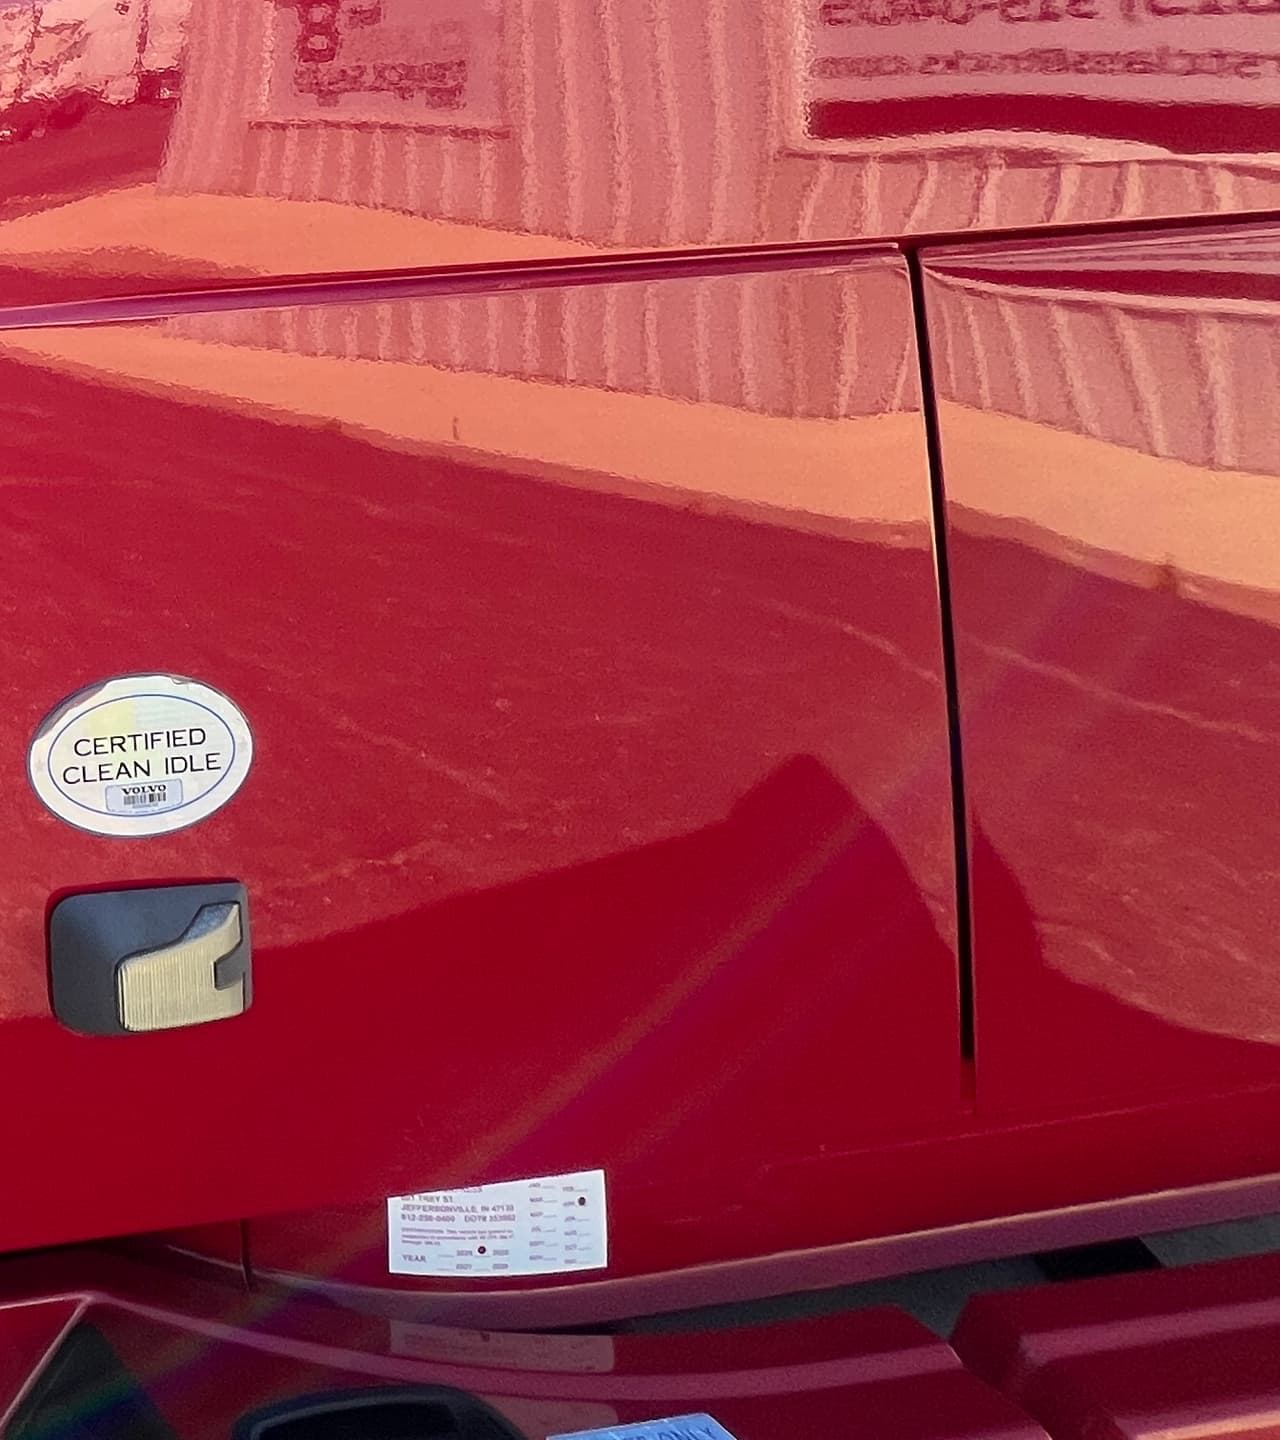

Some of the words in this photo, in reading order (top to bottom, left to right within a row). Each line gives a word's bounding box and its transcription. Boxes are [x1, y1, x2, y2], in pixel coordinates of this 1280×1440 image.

[73, 728, 207, 757] CERTIFIED
[62, 759, 152, 785] CLEAN
[165, 752, 222, 775] IDLE
[121, 784, 167, 796] VOLVO
[402, 1255, 427, 1263] YEAR
